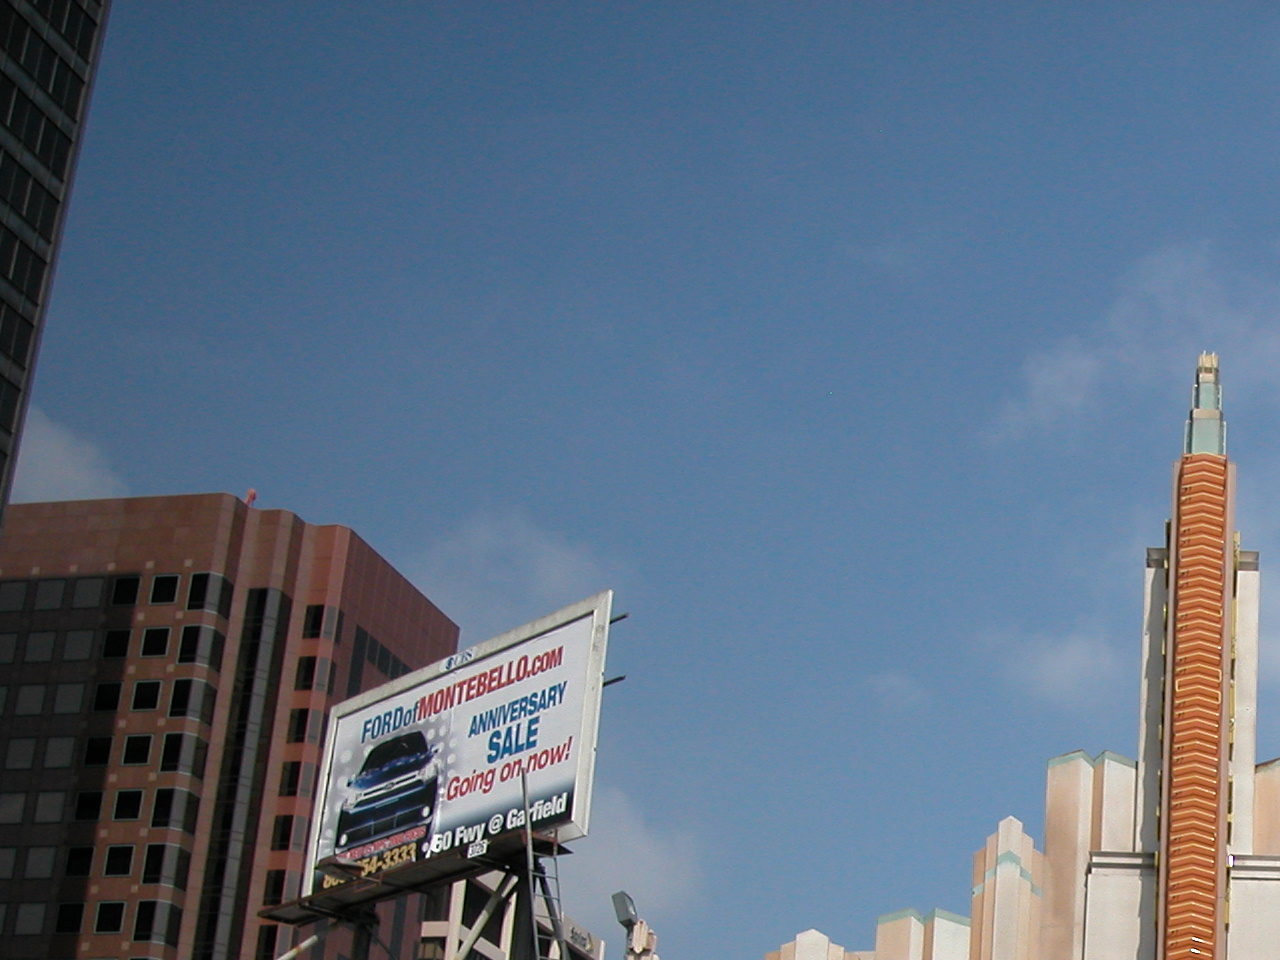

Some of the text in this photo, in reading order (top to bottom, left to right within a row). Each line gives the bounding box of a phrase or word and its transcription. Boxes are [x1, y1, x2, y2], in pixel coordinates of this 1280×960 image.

[467, 681, 567, 738] ANNIVERSARY
[487, 716, 540, 764] SALE
[447, 736, 573, 801] Going on now!
[454, 822, 486, 847] Fwy
[488, 813, 504, 835] @
[506, 792, 568, 830] Garfield
